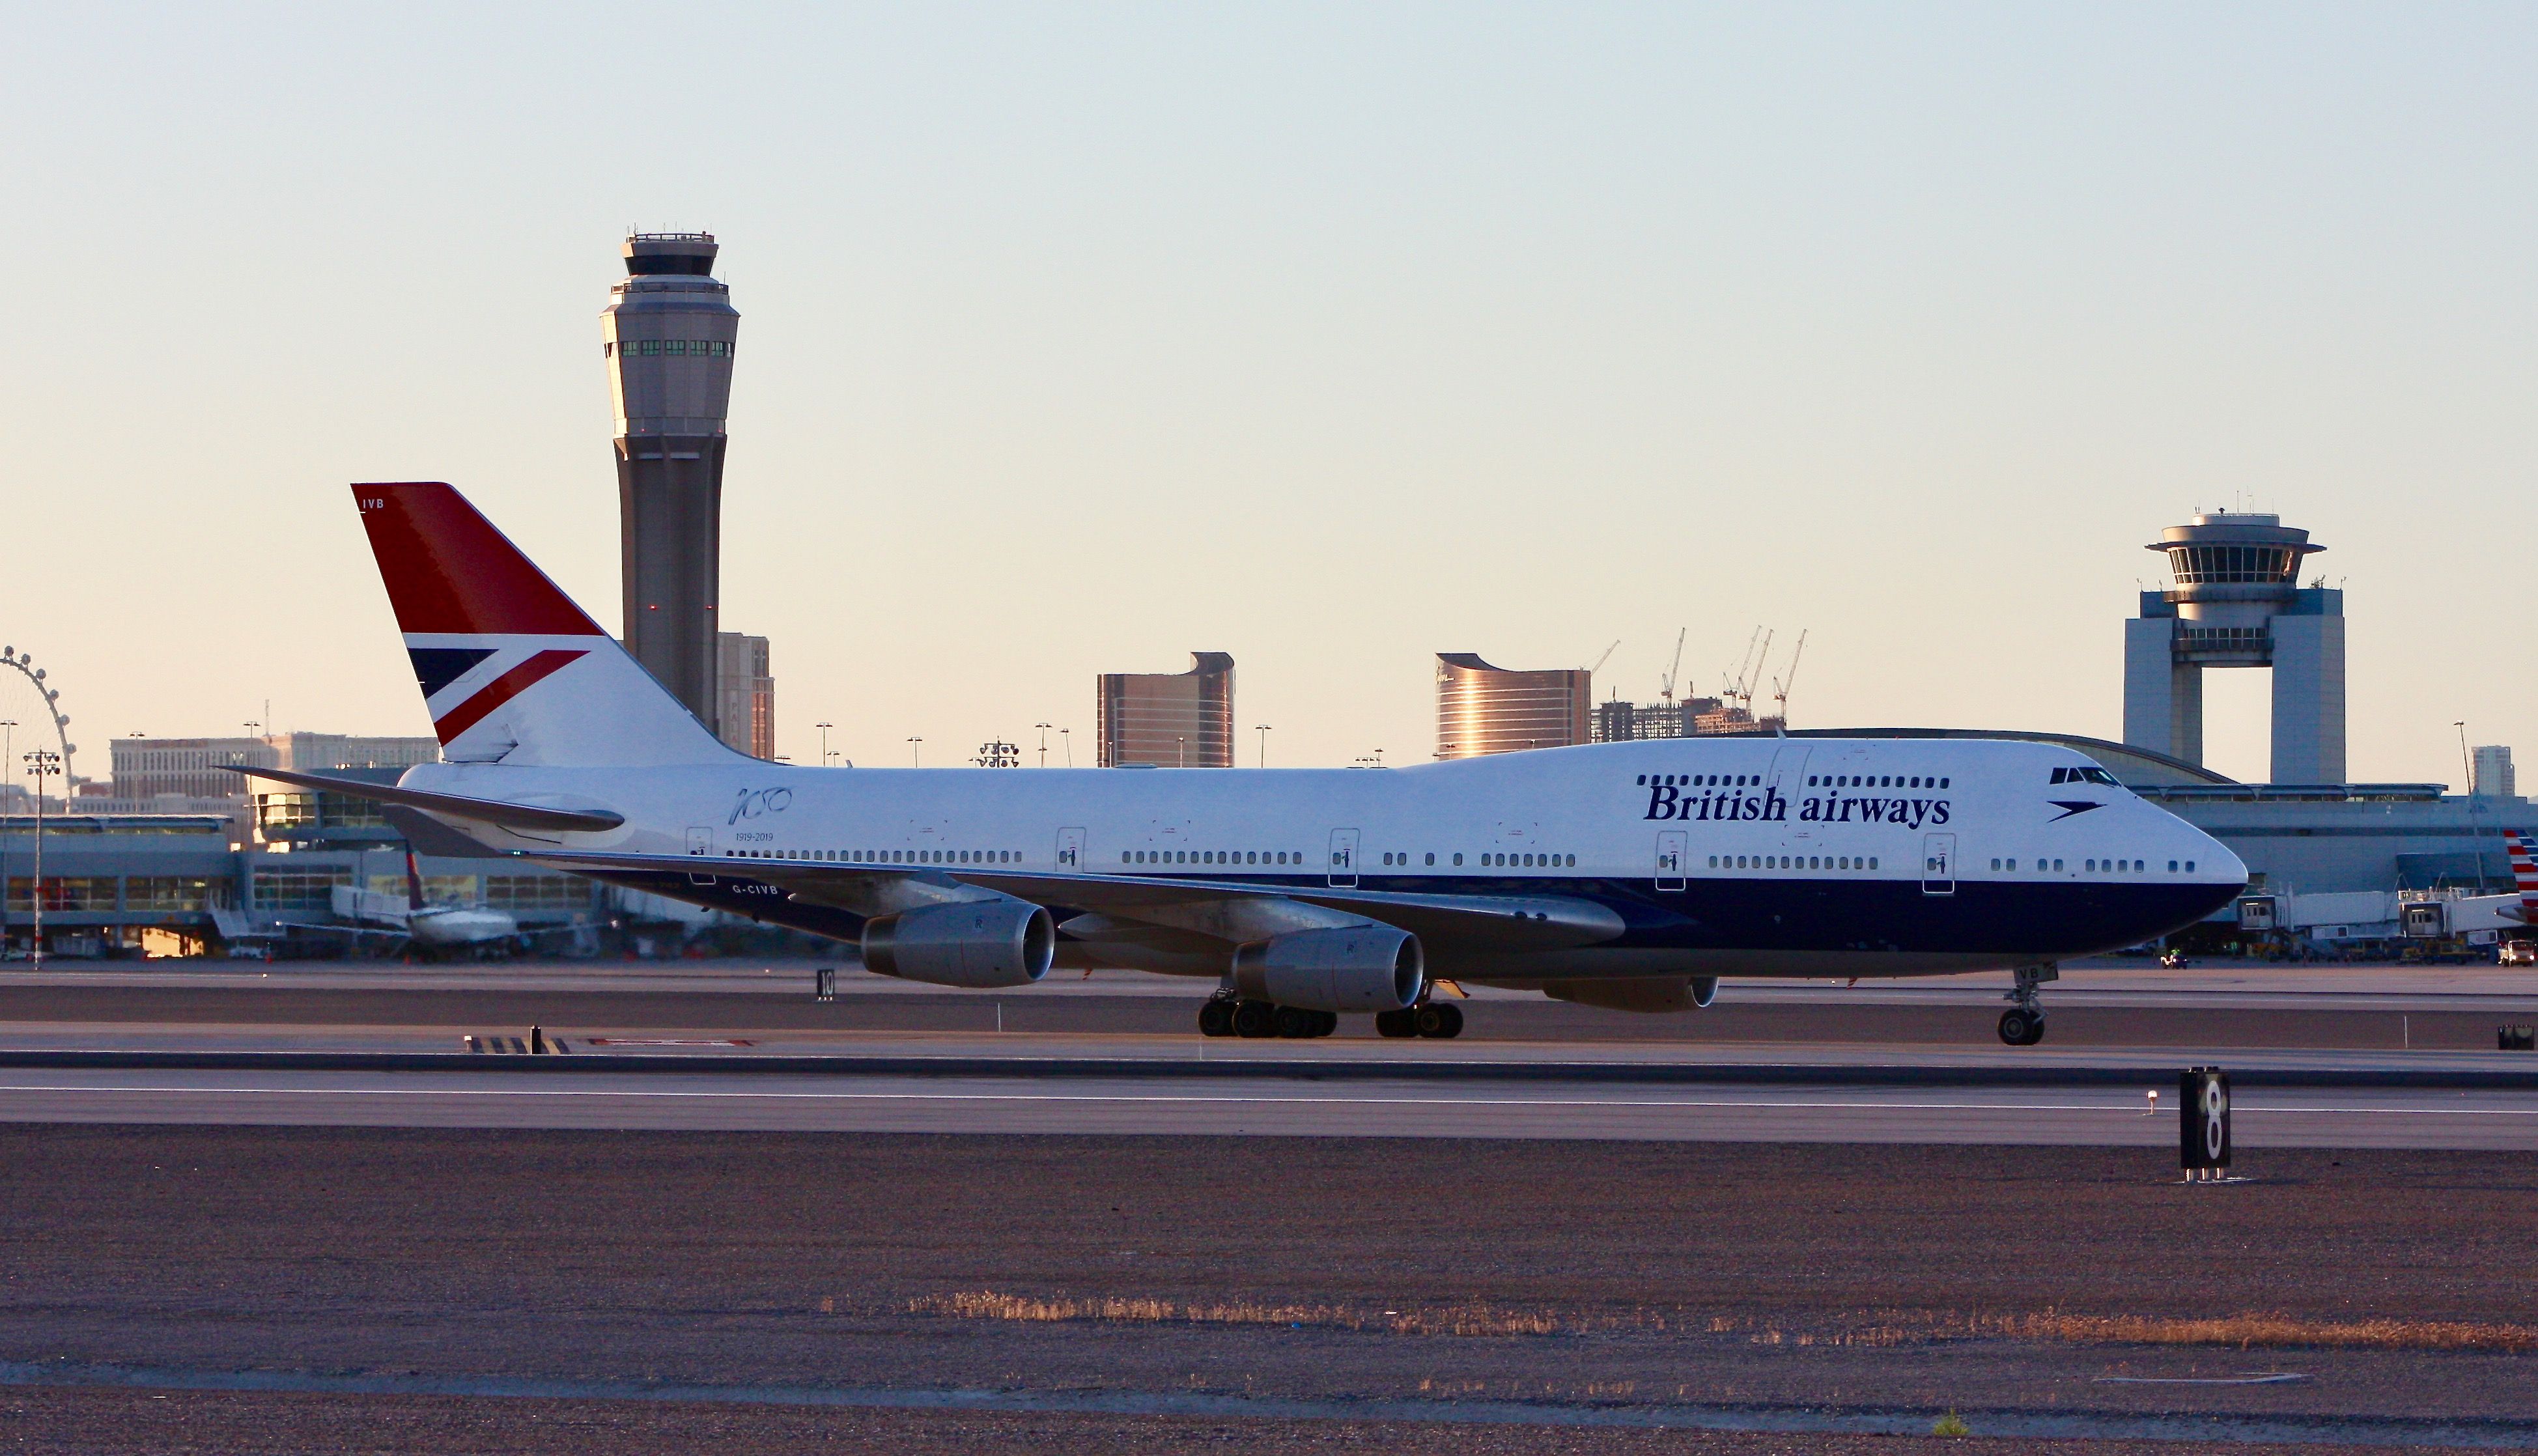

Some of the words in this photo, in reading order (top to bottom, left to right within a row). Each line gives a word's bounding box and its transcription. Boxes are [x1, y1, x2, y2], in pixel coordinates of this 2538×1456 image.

[363, 499, 384, 509] IVB
[1643, 785, 1787, 821] British
[1799, 790, 1951, 830] airways
[736, 833, 774, 841] 1919-2019
[732, 885, 778, 895] G-CIVB
[2020, 968, 2038, 979] VB
[822, 972, 833, 995] 10
[2206, 1080, 2222, 1159] 8
